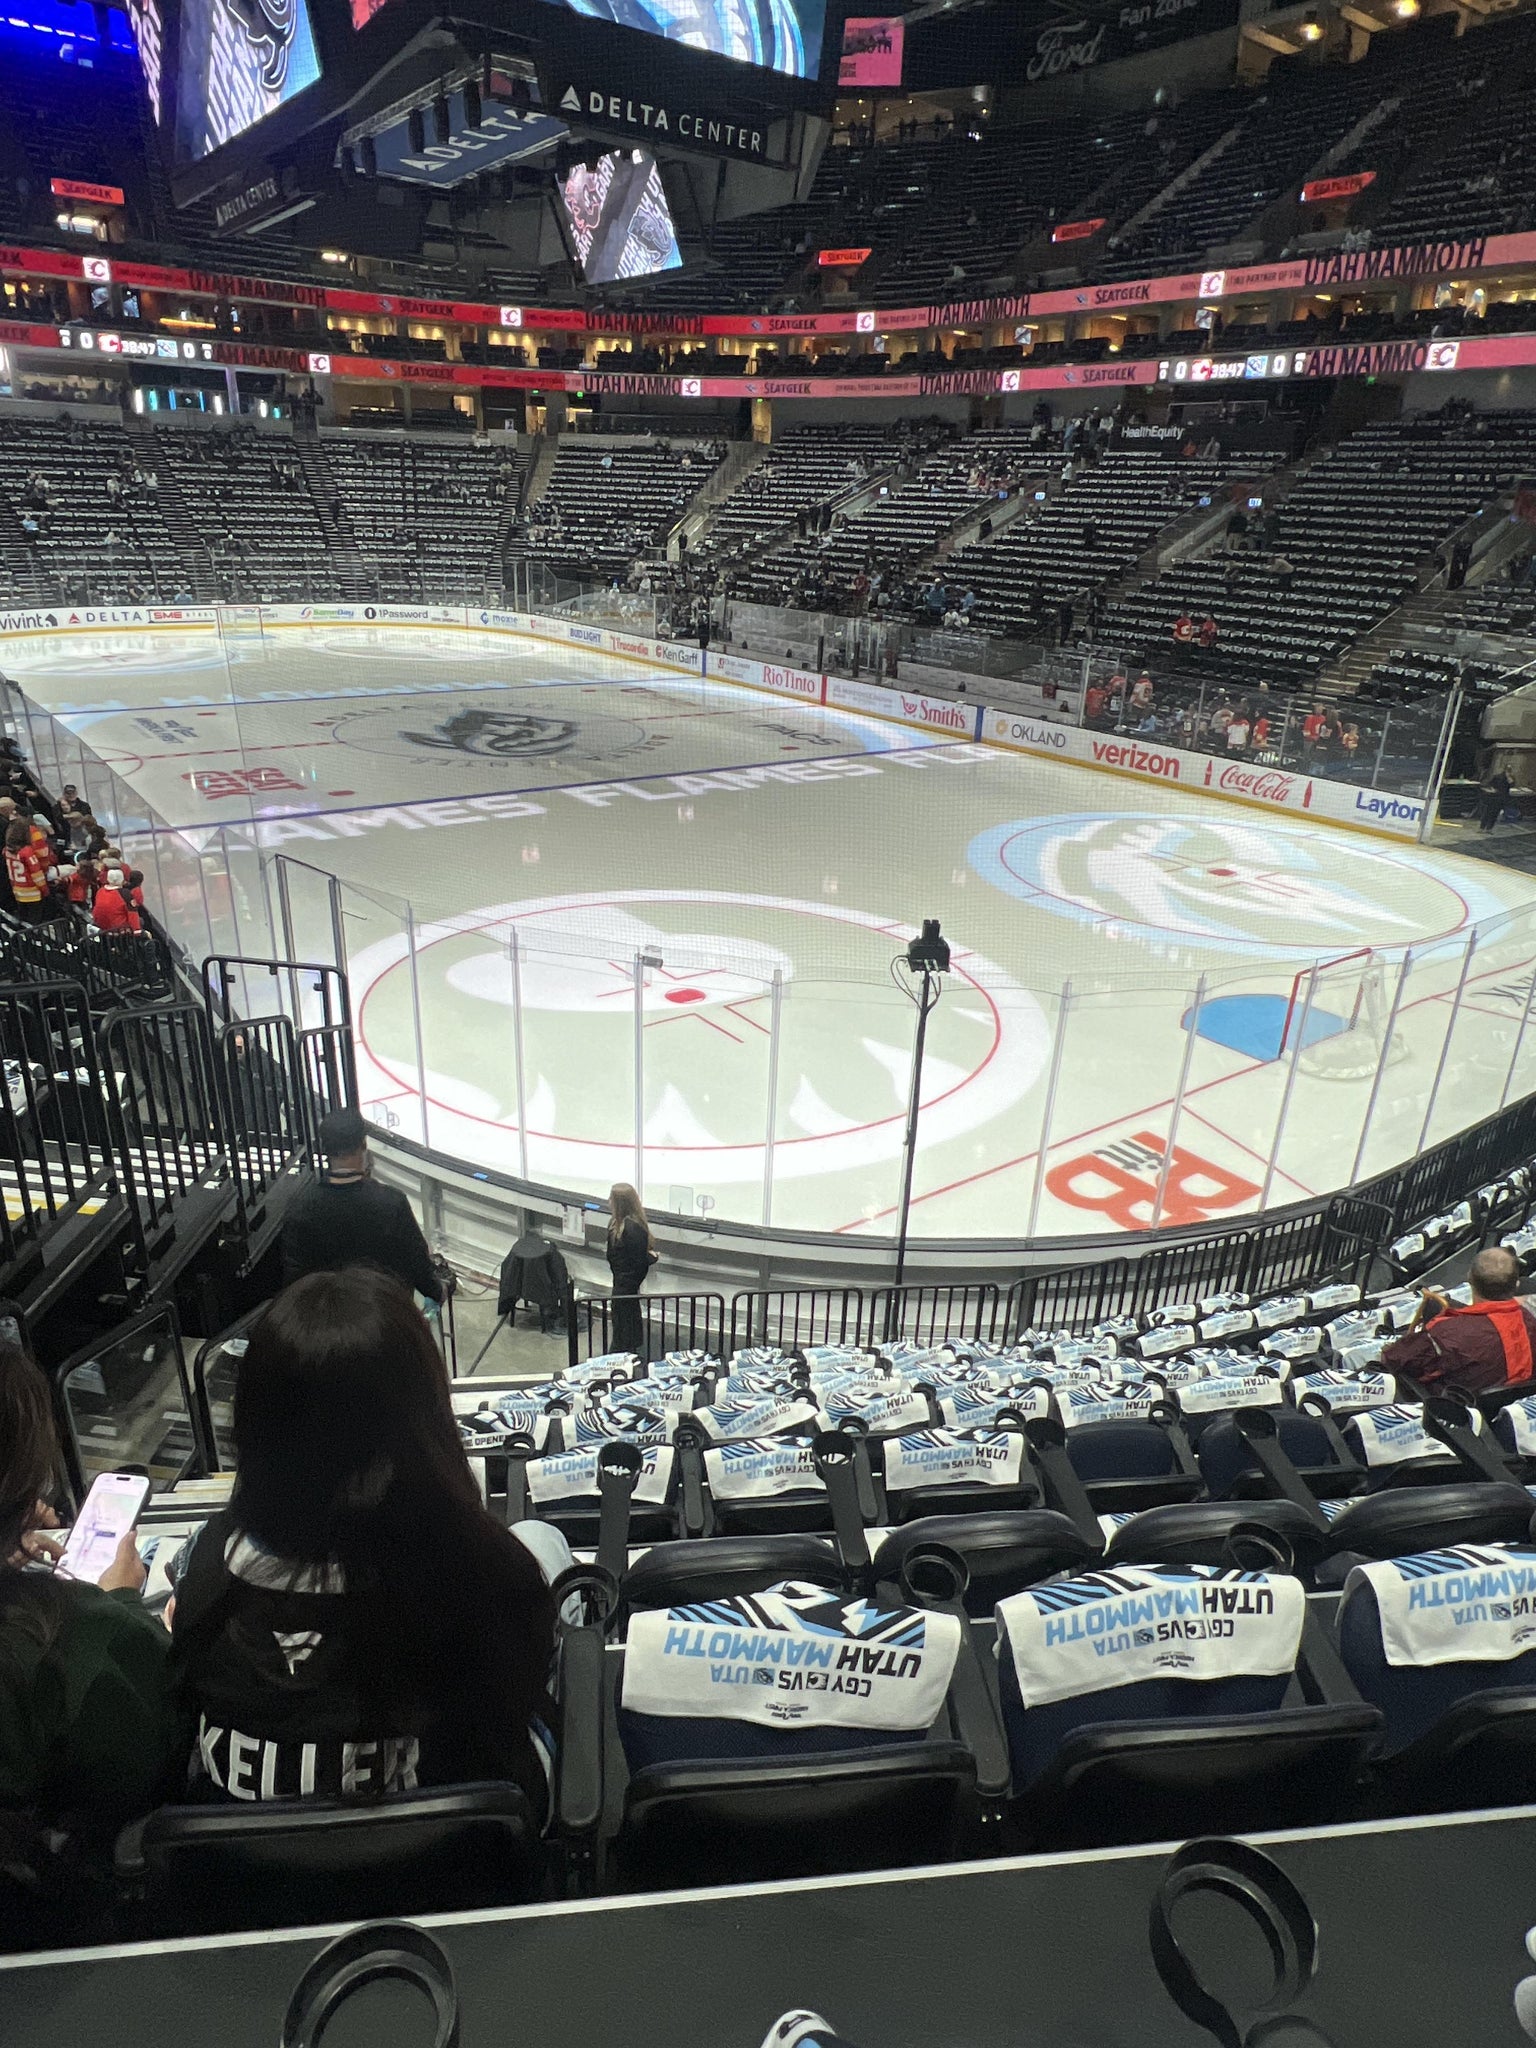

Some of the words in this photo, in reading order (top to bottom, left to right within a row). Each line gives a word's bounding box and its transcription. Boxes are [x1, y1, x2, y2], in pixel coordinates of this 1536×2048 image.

[1026, 19, 1106, 80] Ford
[590, 91, 669, 131] DELTA
[678, 114, 761, 152] CENTER
[221, 195, 248, 227] DELTA
[249, 177, 279, 210] CENTER
[1304, 255, 1357, 286] UTAH
[1362, 237, 1487, 280] MAMMOTH
[1095, 284, 1151, 305] SEATGEEK
[400, 299, 455, 317] SEATGEEK
[928, 303, 960, 326] UTAH
[962, 294, 1031, 322] MAMMOTH
[587, 311, 626, 332] UTAH
[627, 313, 704, 335] MAMMOTH
[768, 318, 817, 331] SEATGEEK
[400, 364, 455, 380] SEATGEEK
[1082, 365, 1137, 383] SEATGEEK
[1175, 361, 1187, 380] 0
[1272, 354, 1286, 374] 0
[583, 373, 623, 392] UTAH
[763, 381, 812, 394] SEATGEEK
[920, 374, 951, 395] UTAH
[1121, 424, 1186, 440] HealthEquity
[86, 611, 142, 622] DELTA
[153, 611, 183, 620] SME
[378, 609, 429, 619] 1Password
[492, 614, 518, 624] moxie
[570, 627, 583, 638] BUD
[583, 630, 602, 643] LIGHT
[662, 646, 677, 661] Ken
[678, 650, 698, 665] Garff
[762, 665, 783, 687] Rio
[783, 669, 816, 694] Tinto
[920, 699, 966, 729] Smith's
[1011, 723, 1066, 748] OKLAND
[1092, 741, 1180, 778] verizon
[557, 757, 886, 808] FLAMES
[1355, 791, 1424, 821] Layton
[6, 858, 28, 884] 12
[1243, 1377, 1270, 1387] UTAH
[886, 1394, 914, 1409] UTAH
[1008, 1401, 1037, 1411] UTAH
[1125, 1400, 1152, 1410] UTAH
[636, 1432, 667, 1444] UTAH
[724, 1451, 796, 1475] MAMMOTH
[902, 1447, 973, 1465] MAMMOTH
[975, 1447, 1009, 1461] UTAH
[975, 1460, 992, 1469] CGY
[951, 1460, 963, 1470] VS
[1201, 1587, 1274, 1615] UTAH
[1512, 1597, 1529, 1618] VS
[1045, 1588, 1200, 1647] MAMMOTH
[1452, 1603, 1488, 1626] UTA
[1157, 1619, 1185, 1642] VS
[664, 1626, 834, 1669] MAMMOTH
[1092, 1634, 1132, 1657] UTA
[836, 1644, 923, 1679] UTAH
[709, 1664, 749, 1685] UTA
[778, 1670, 803, 1691] VS
[830, 1678, 873, 1698] CGY
